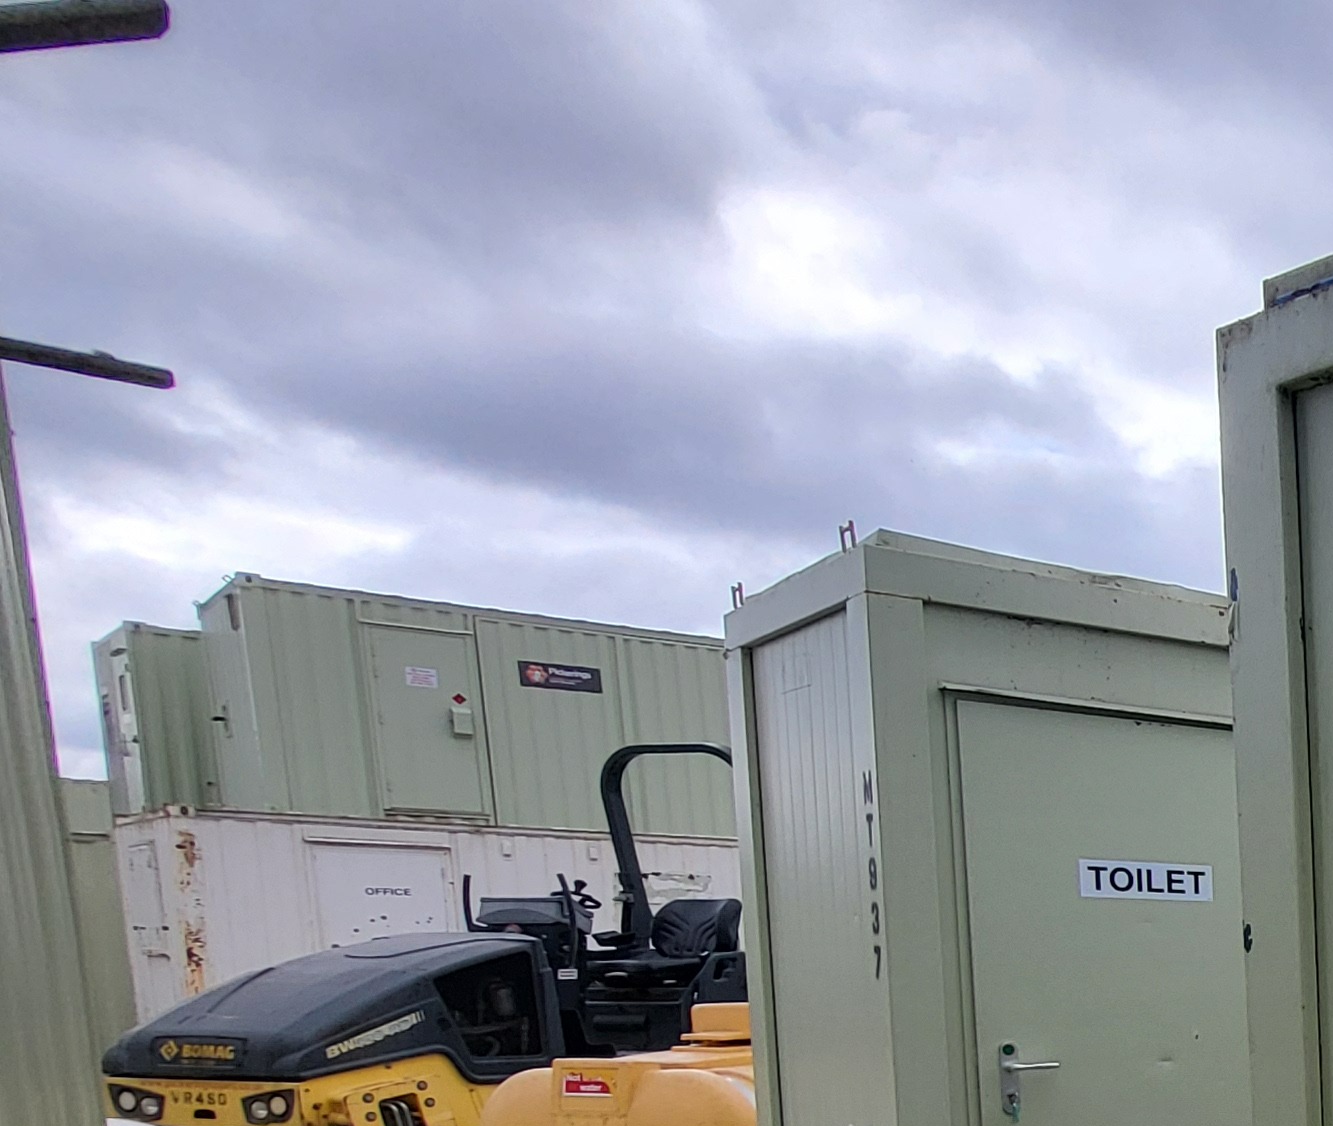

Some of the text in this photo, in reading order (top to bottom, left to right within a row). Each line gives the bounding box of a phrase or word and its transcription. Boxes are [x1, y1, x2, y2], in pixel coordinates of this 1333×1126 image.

[1086, 865, 1207, 895] TOILET
[364, 887, 413, 896] OFFICE
[181, 1043, 236, 1060] BOMAG
